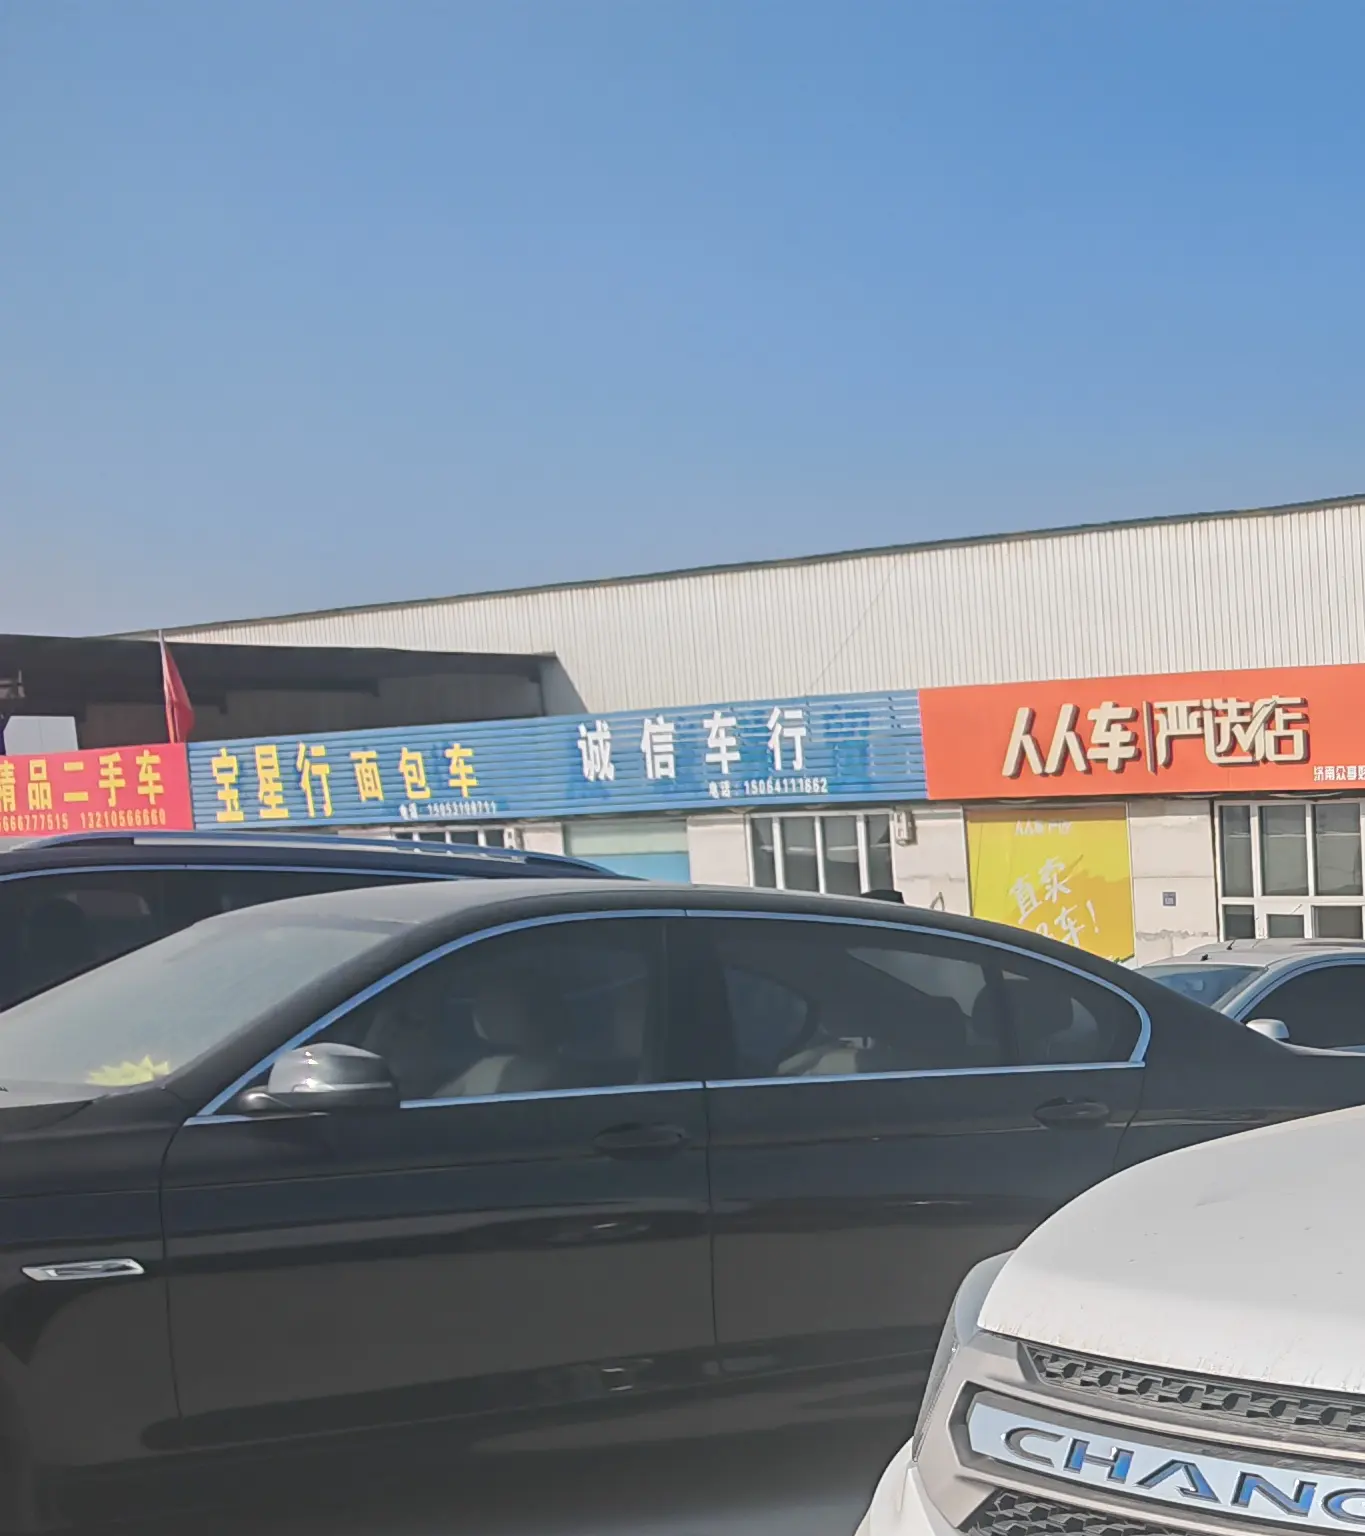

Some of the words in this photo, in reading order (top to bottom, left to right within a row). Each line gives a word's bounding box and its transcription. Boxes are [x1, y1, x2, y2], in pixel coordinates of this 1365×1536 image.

[577, 706, 807, 782] 诚信车行
[1001, 701, 1141, 779] 人人车
